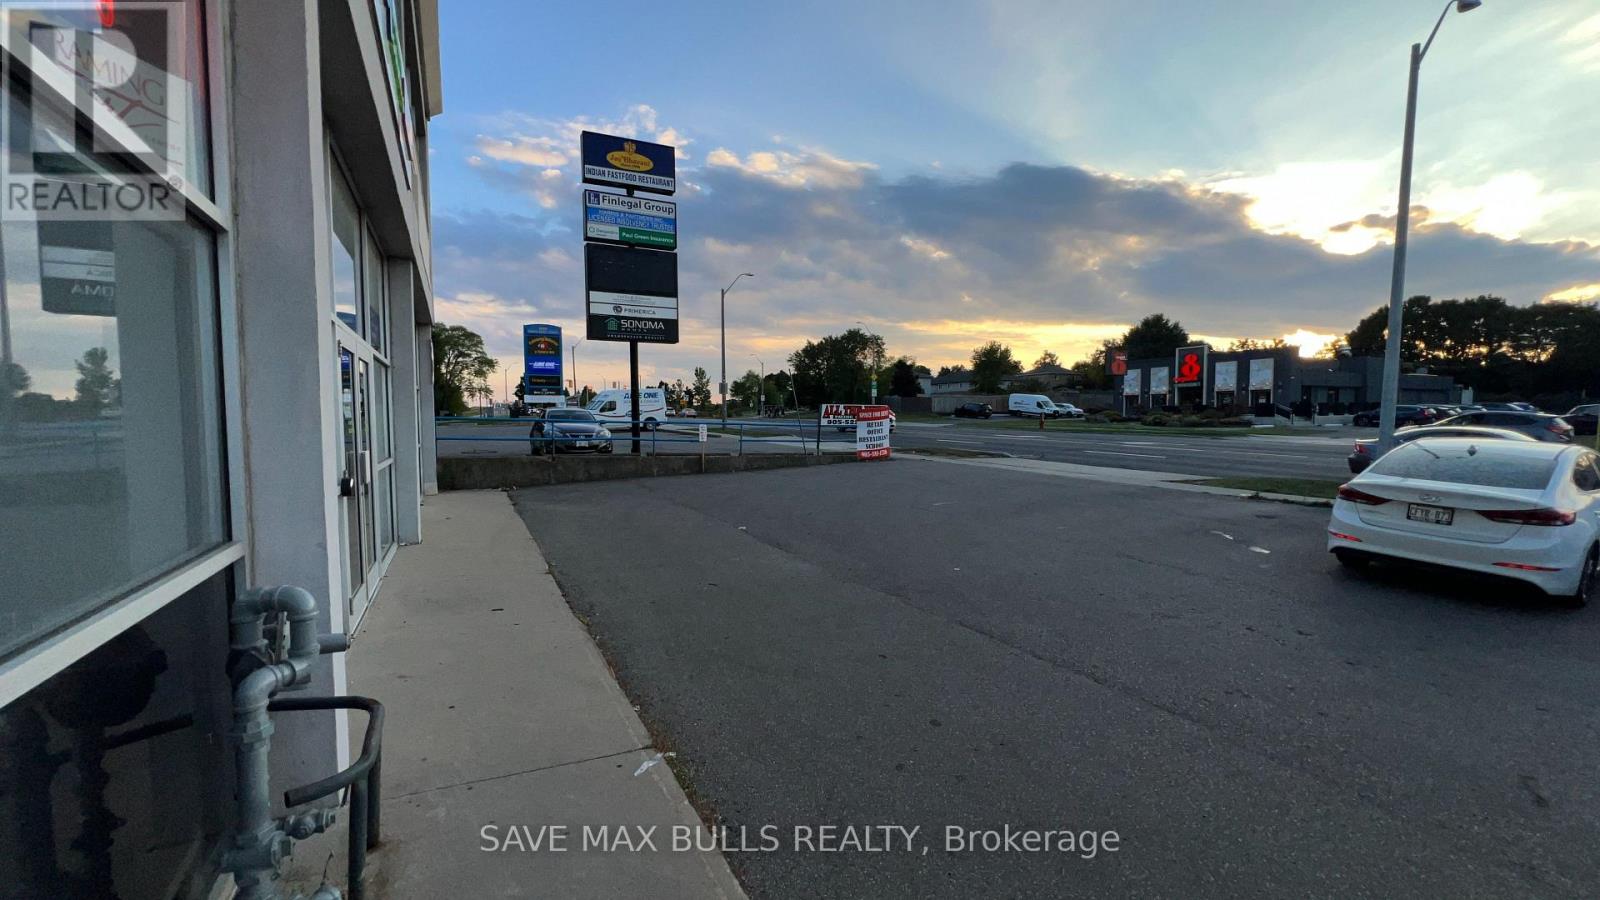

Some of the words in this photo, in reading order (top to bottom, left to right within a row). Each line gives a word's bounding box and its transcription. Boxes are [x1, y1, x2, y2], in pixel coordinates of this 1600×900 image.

[585, 167, 606, 177] INDIAN
[607, 170, 637, 182] FASTFOOD
[638, 175, 674, 187] RESTAURANT
[602, 195, 641, 209] Finlegal
[644, 202, 674, 215] Group
[588, 213, 616, 223] LICENSED
[616, 217, 649, 228] INSOLVENCY
[651, 223, 673, 231] TRUSTEE
[650, 234, 674, 243] Insurance
[624, 307, 657, 315] PRIMERICA
[621, 319, 665, 331] SONOMA
